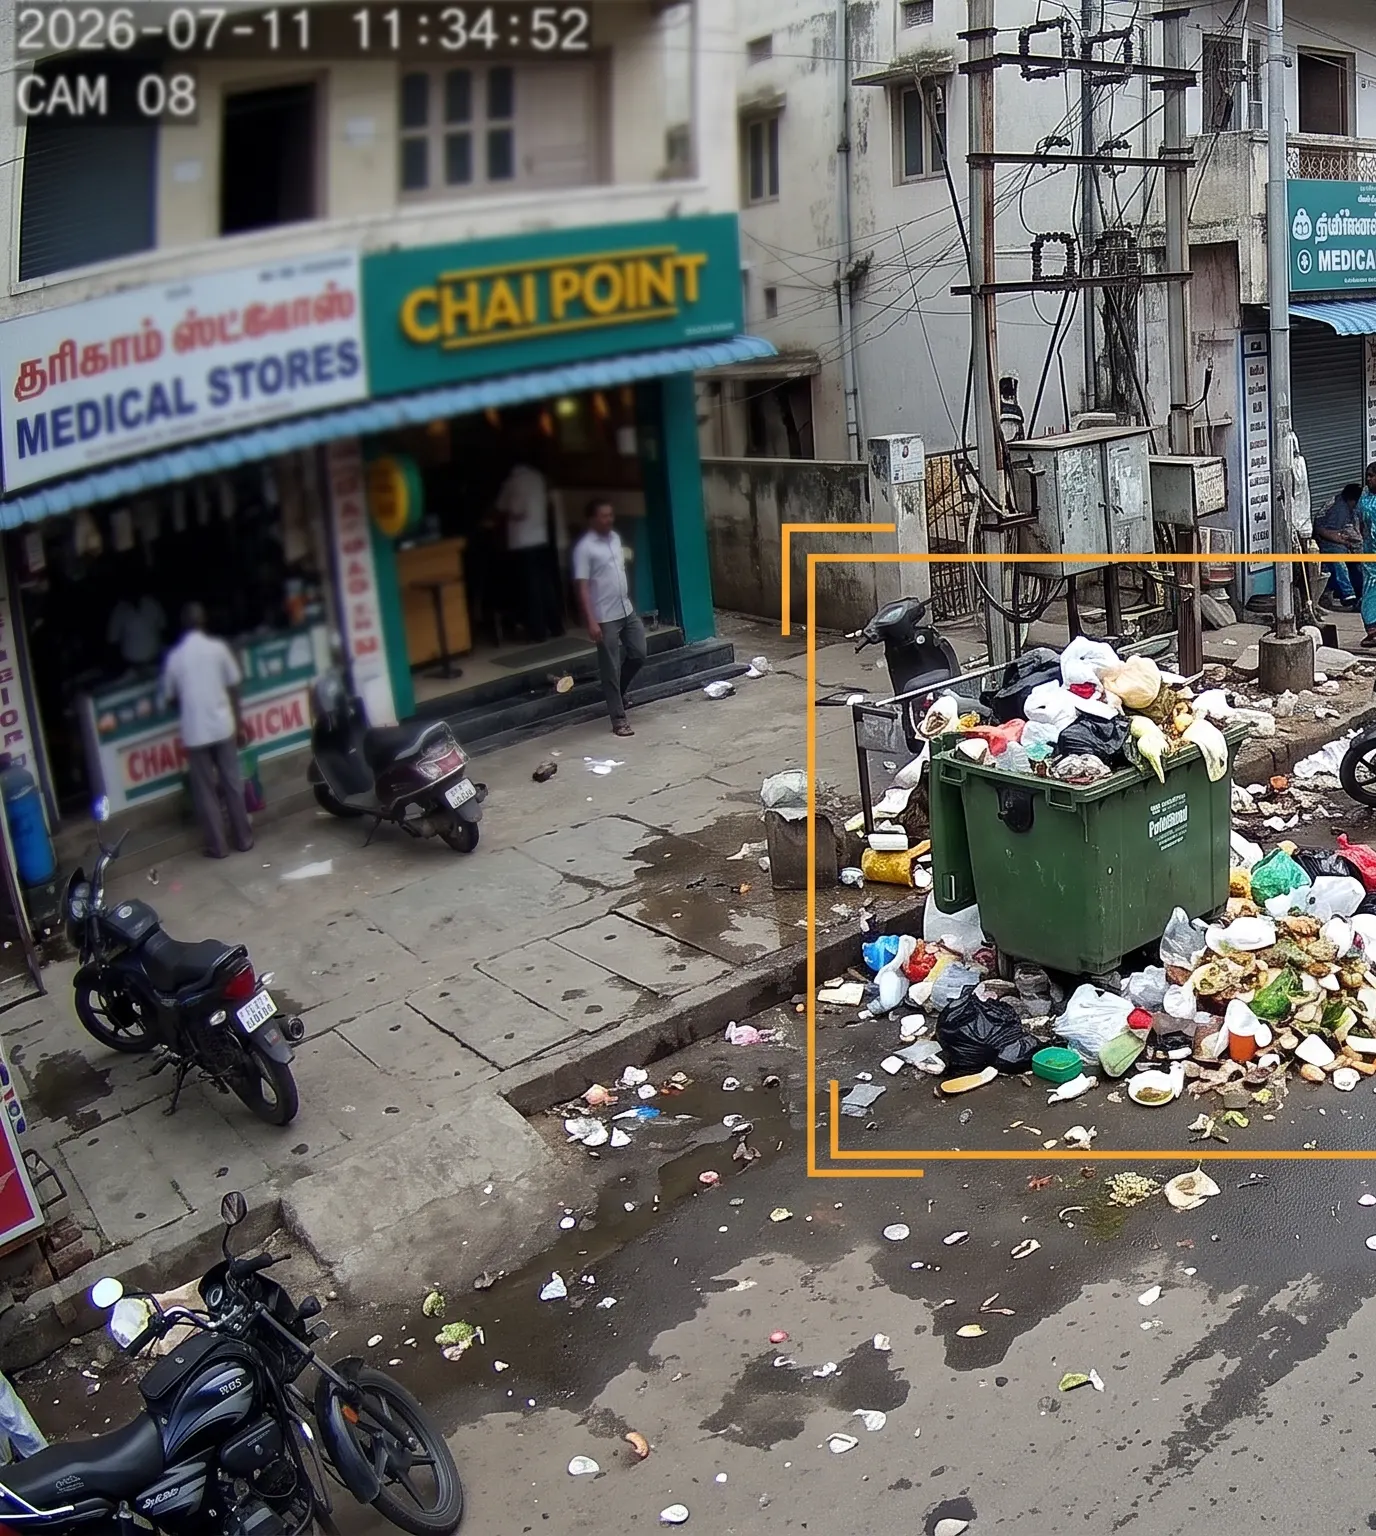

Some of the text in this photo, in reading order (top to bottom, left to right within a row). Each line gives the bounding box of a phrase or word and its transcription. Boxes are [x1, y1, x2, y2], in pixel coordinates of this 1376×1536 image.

[400, 252, 707, 344] CHAI POINT
[16, 377, 198, 460] MEDICAL
[207, 339, 361, 407] STORES
